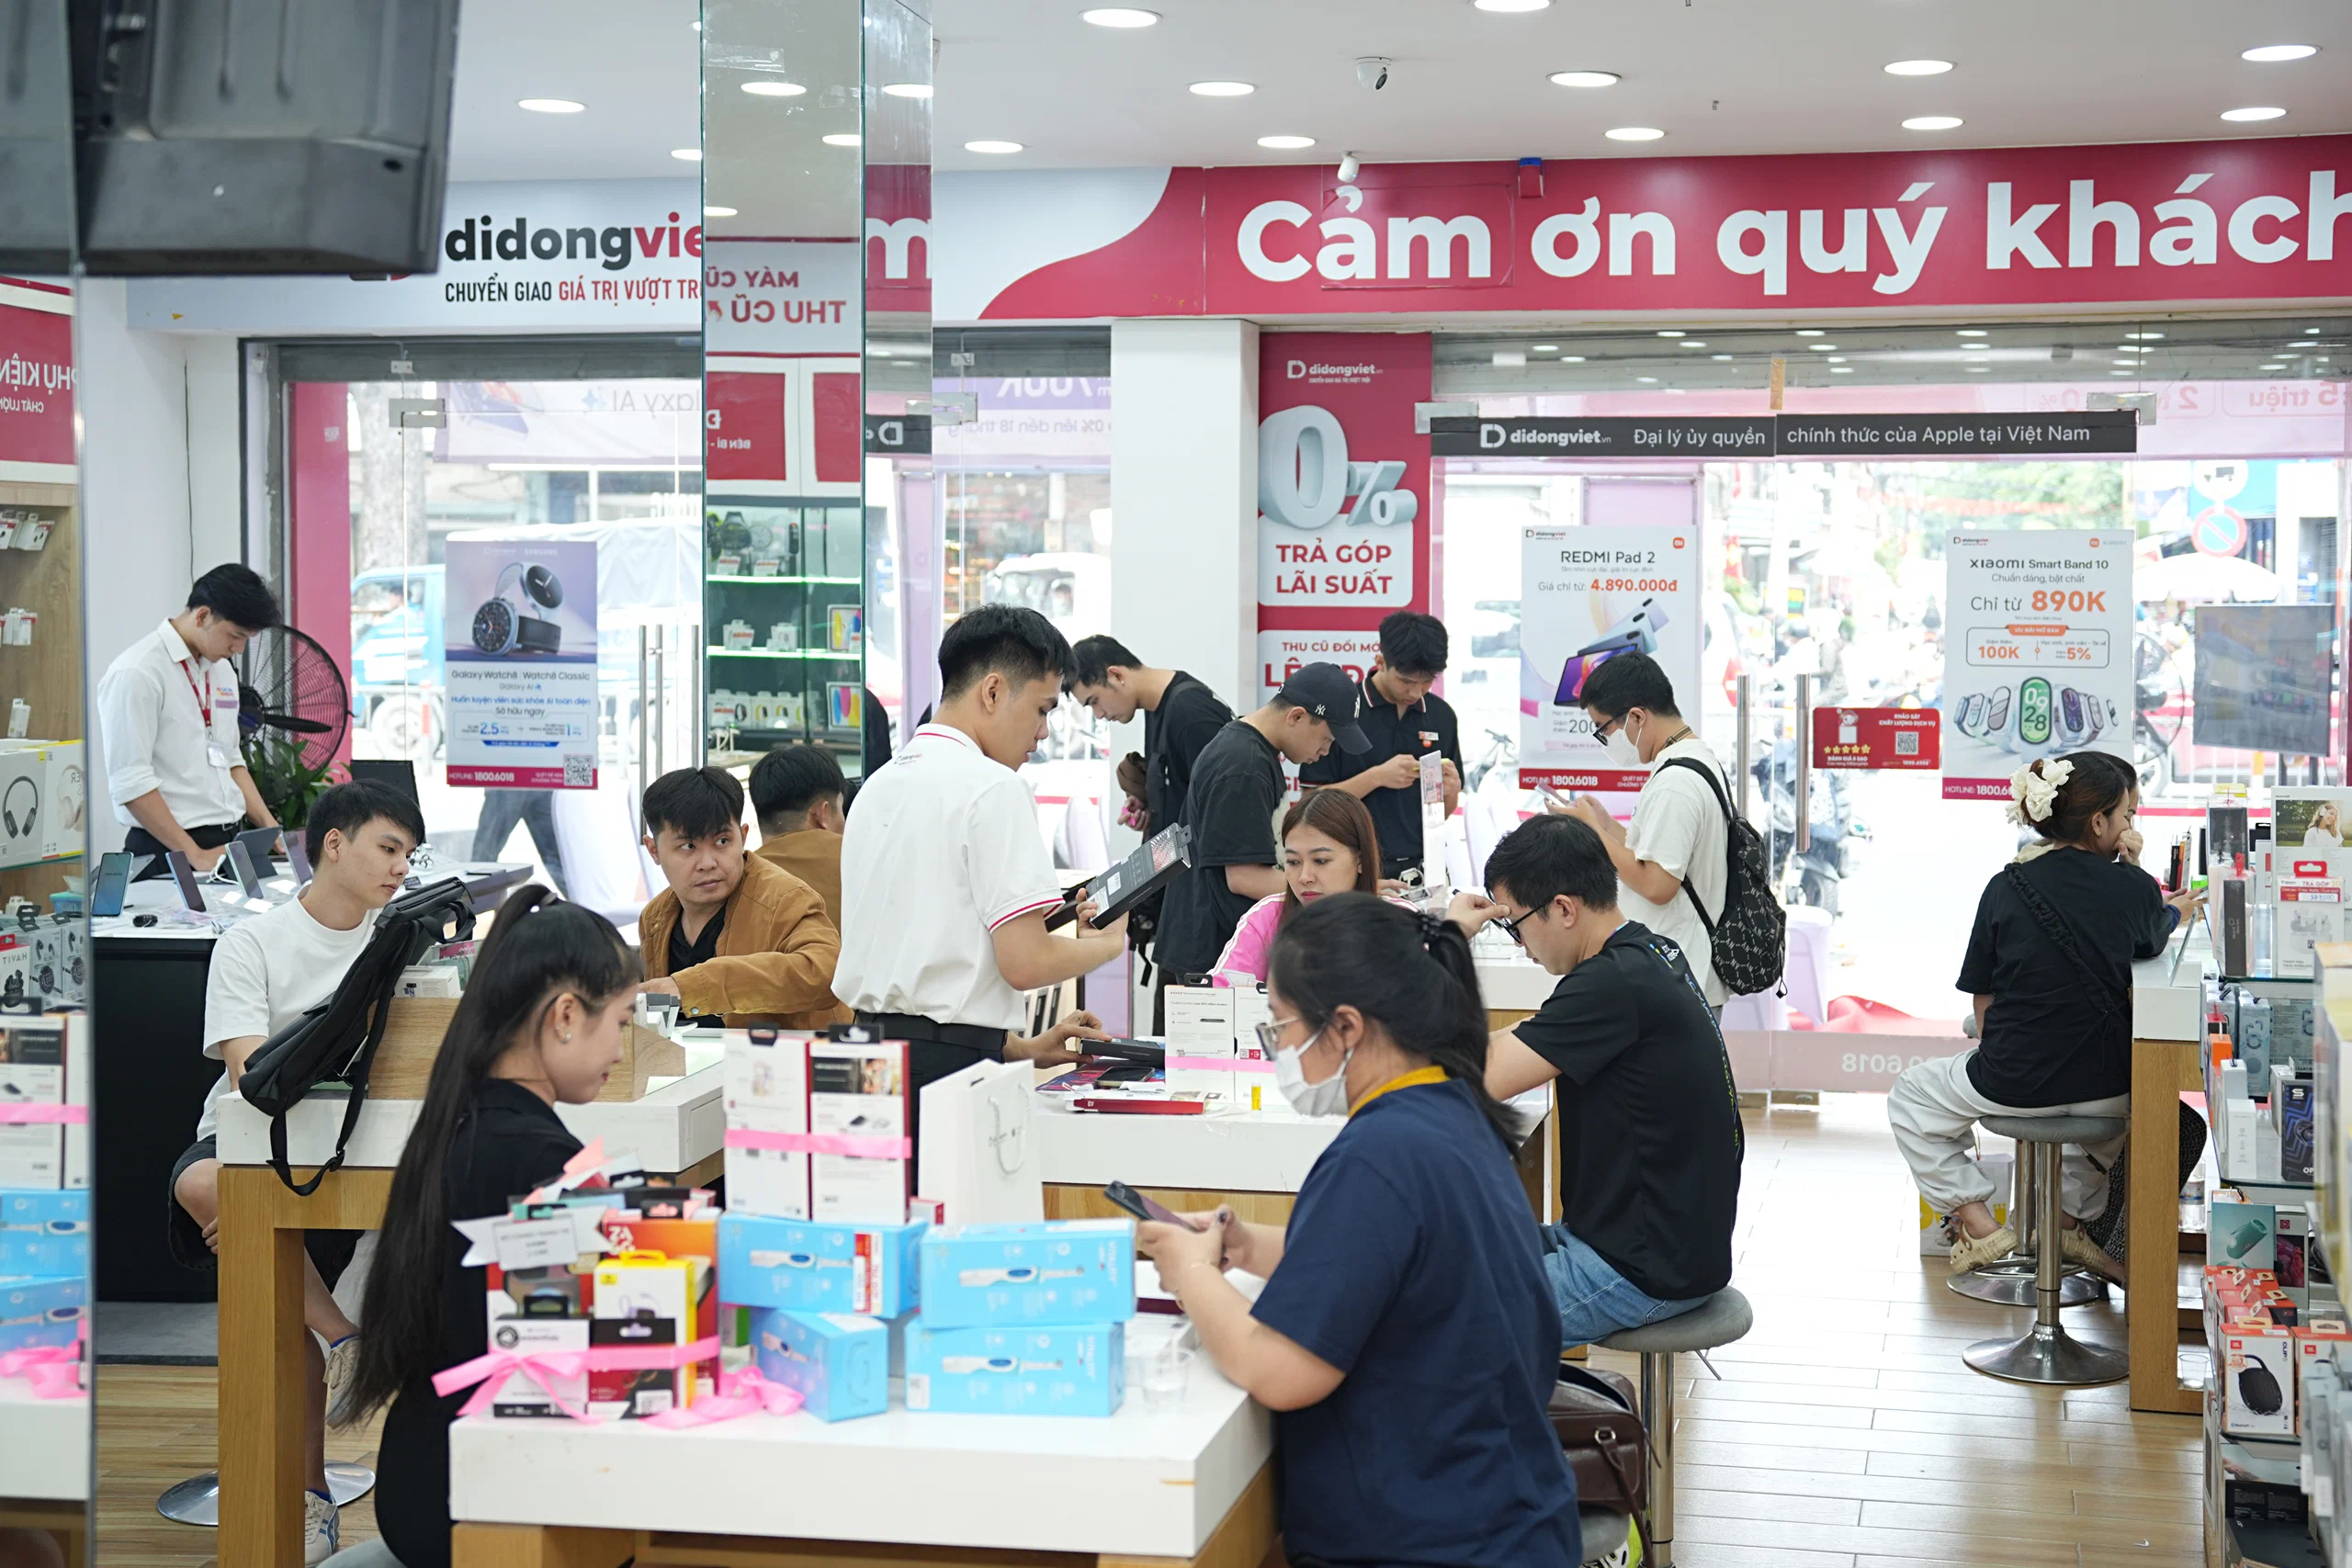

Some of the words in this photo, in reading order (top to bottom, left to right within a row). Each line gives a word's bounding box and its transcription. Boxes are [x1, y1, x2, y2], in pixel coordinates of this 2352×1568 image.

[1238, 184, 1491, 282] Cảm
[1532, 196, 1676, 277] ơn
[1718, 182, 1948, 295] quý
[1986, 170, 2352, 269] khách
[446, 272, 507, 302] CHUYỂN
[514, 281, 551, 302] GIAO
[559, 275, 585, 300] GIÁ
[592, 280, 618, 306] TRỊ
[625, 276, 672, 306] VƯỢT
[677, 279, 701, 299] TR
[1634, 429, 1662, 446] Đại
[1668, 428, 1681, 446] lý
[1687, 426, 1707, 447] ủy
[1713, 426, 1765, 448] quyền
[1787, 426, 1835, 443] chính
[1840, 426, 1880, 443] thức
[1885, 426, 1917, 443] của
[1922, 426, 1974, 446] Apple
[1980, 425, 2001, 446] tại
[2007, 425, 2042, 445] Việt
[2048, 425, 2090, 442] Nam
[1258, 405, 1418, 530] 0%
[1276, 537, 1328, 563] TRẢ
[1336, 539, 1392, 563] GÓP
[1561, 551, 1610, 563] REDMI
[1616, 551, 1641, 563] Pad
[1647, 552, 1656, 564] 2
[2029, 559, 2062, 569] Smart
[2064, 558, 2092, 570] Band
[2096, 559, 2109, 570] 10
[1276, 570, 1317, 594] LÃI
[1326, 569, 1392, 594] SUẤT
[2065, 572, 2085, 583] chất
[1538, 581, 1554, 591] Giá
[1590, 579, 1679, 592] 4.890.000đ
[1971, 596, 1997, 612] Chỉ
[2005, 596, 2022, 612] từ
[2031, 590, 2107, 613] 890K
[1283, 642, 1307, 651] THU
[1312, 640, 1329, 651] CŨ
[1333, 639, 1356, 652] ĐỔI
[1978, 646, 2019, 659] 100K
[2067, 648, 2091, 660] 5%
[452, 671, 482, 681] Galaxy
[559, 671, 590, 681] Classic
